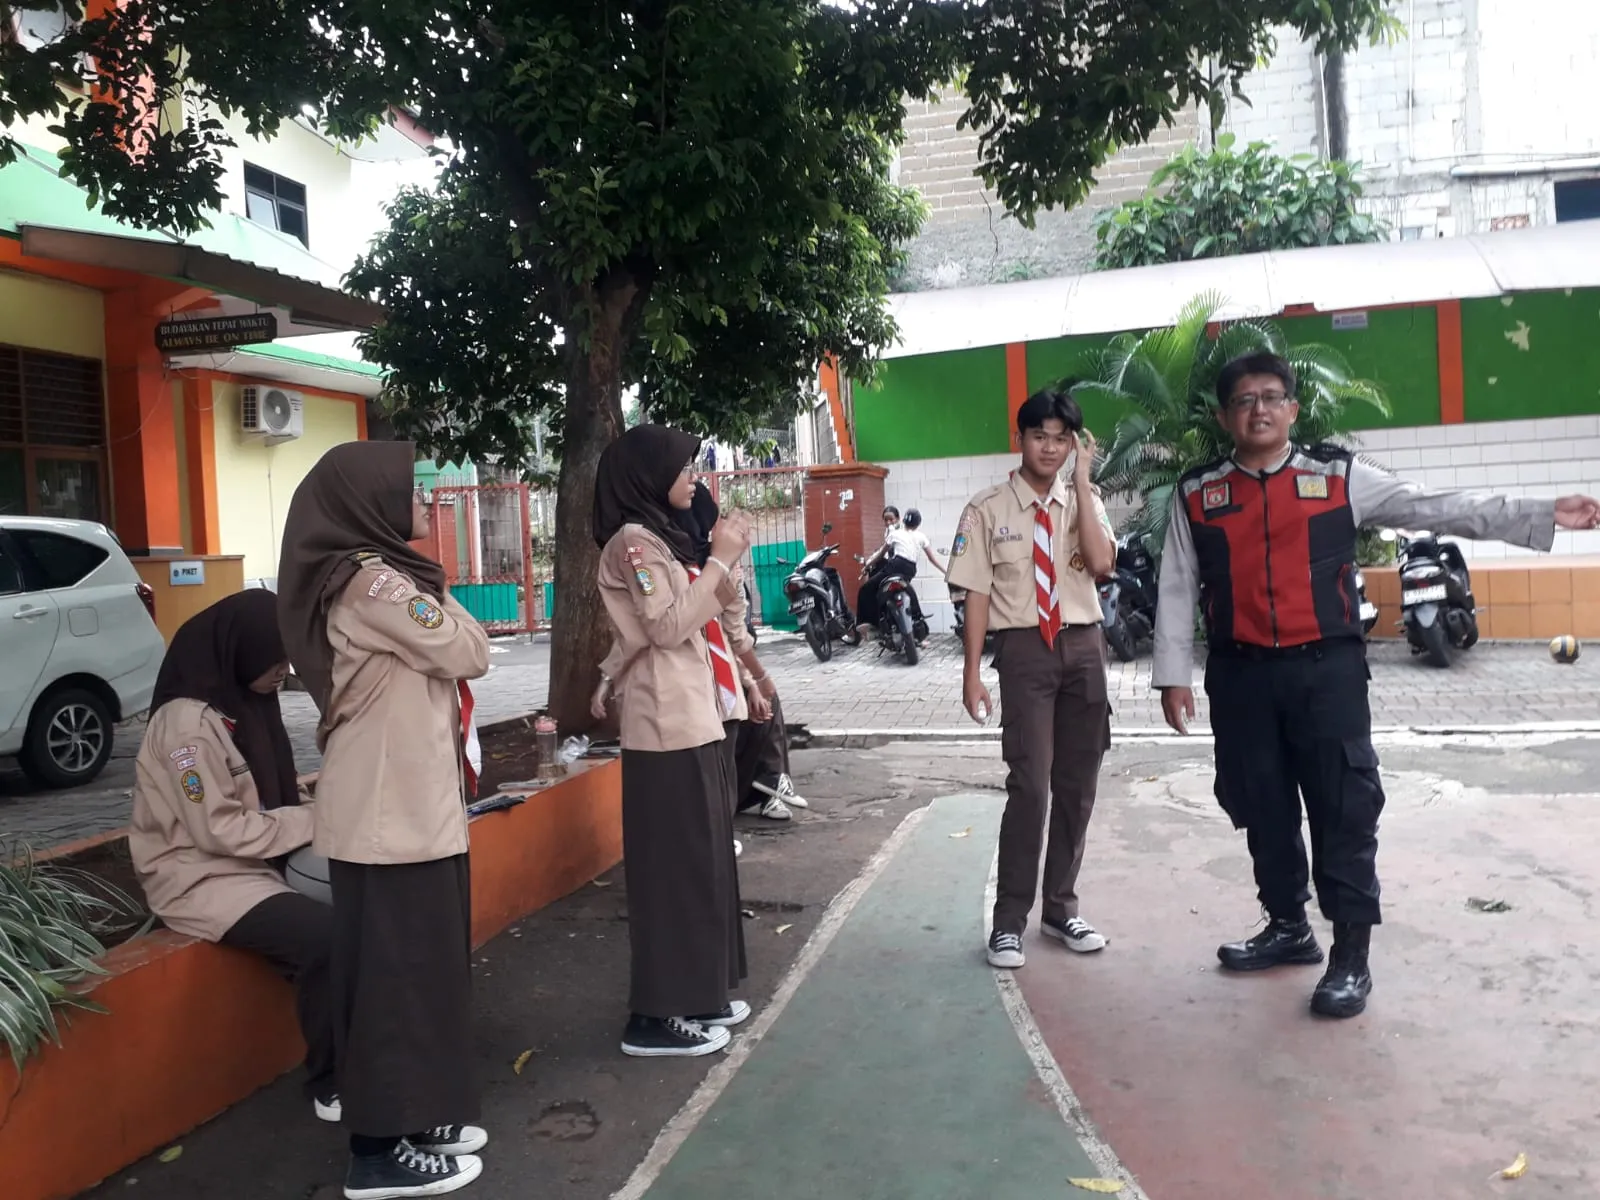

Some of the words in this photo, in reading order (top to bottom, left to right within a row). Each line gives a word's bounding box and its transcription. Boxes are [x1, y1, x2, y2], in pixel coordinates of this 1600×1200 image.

[160, 322, 210, 335] BUDAYAKAN
[212, 320, 237, 331] TEPAT
[240, 317, 269, 328] WAKTU
[161, 336, 202, 348] ALWAYS
[205, 334, 218, 344] BE
[223, 332, 239, 343] ON
[243, 330, 267, 341] TIME
